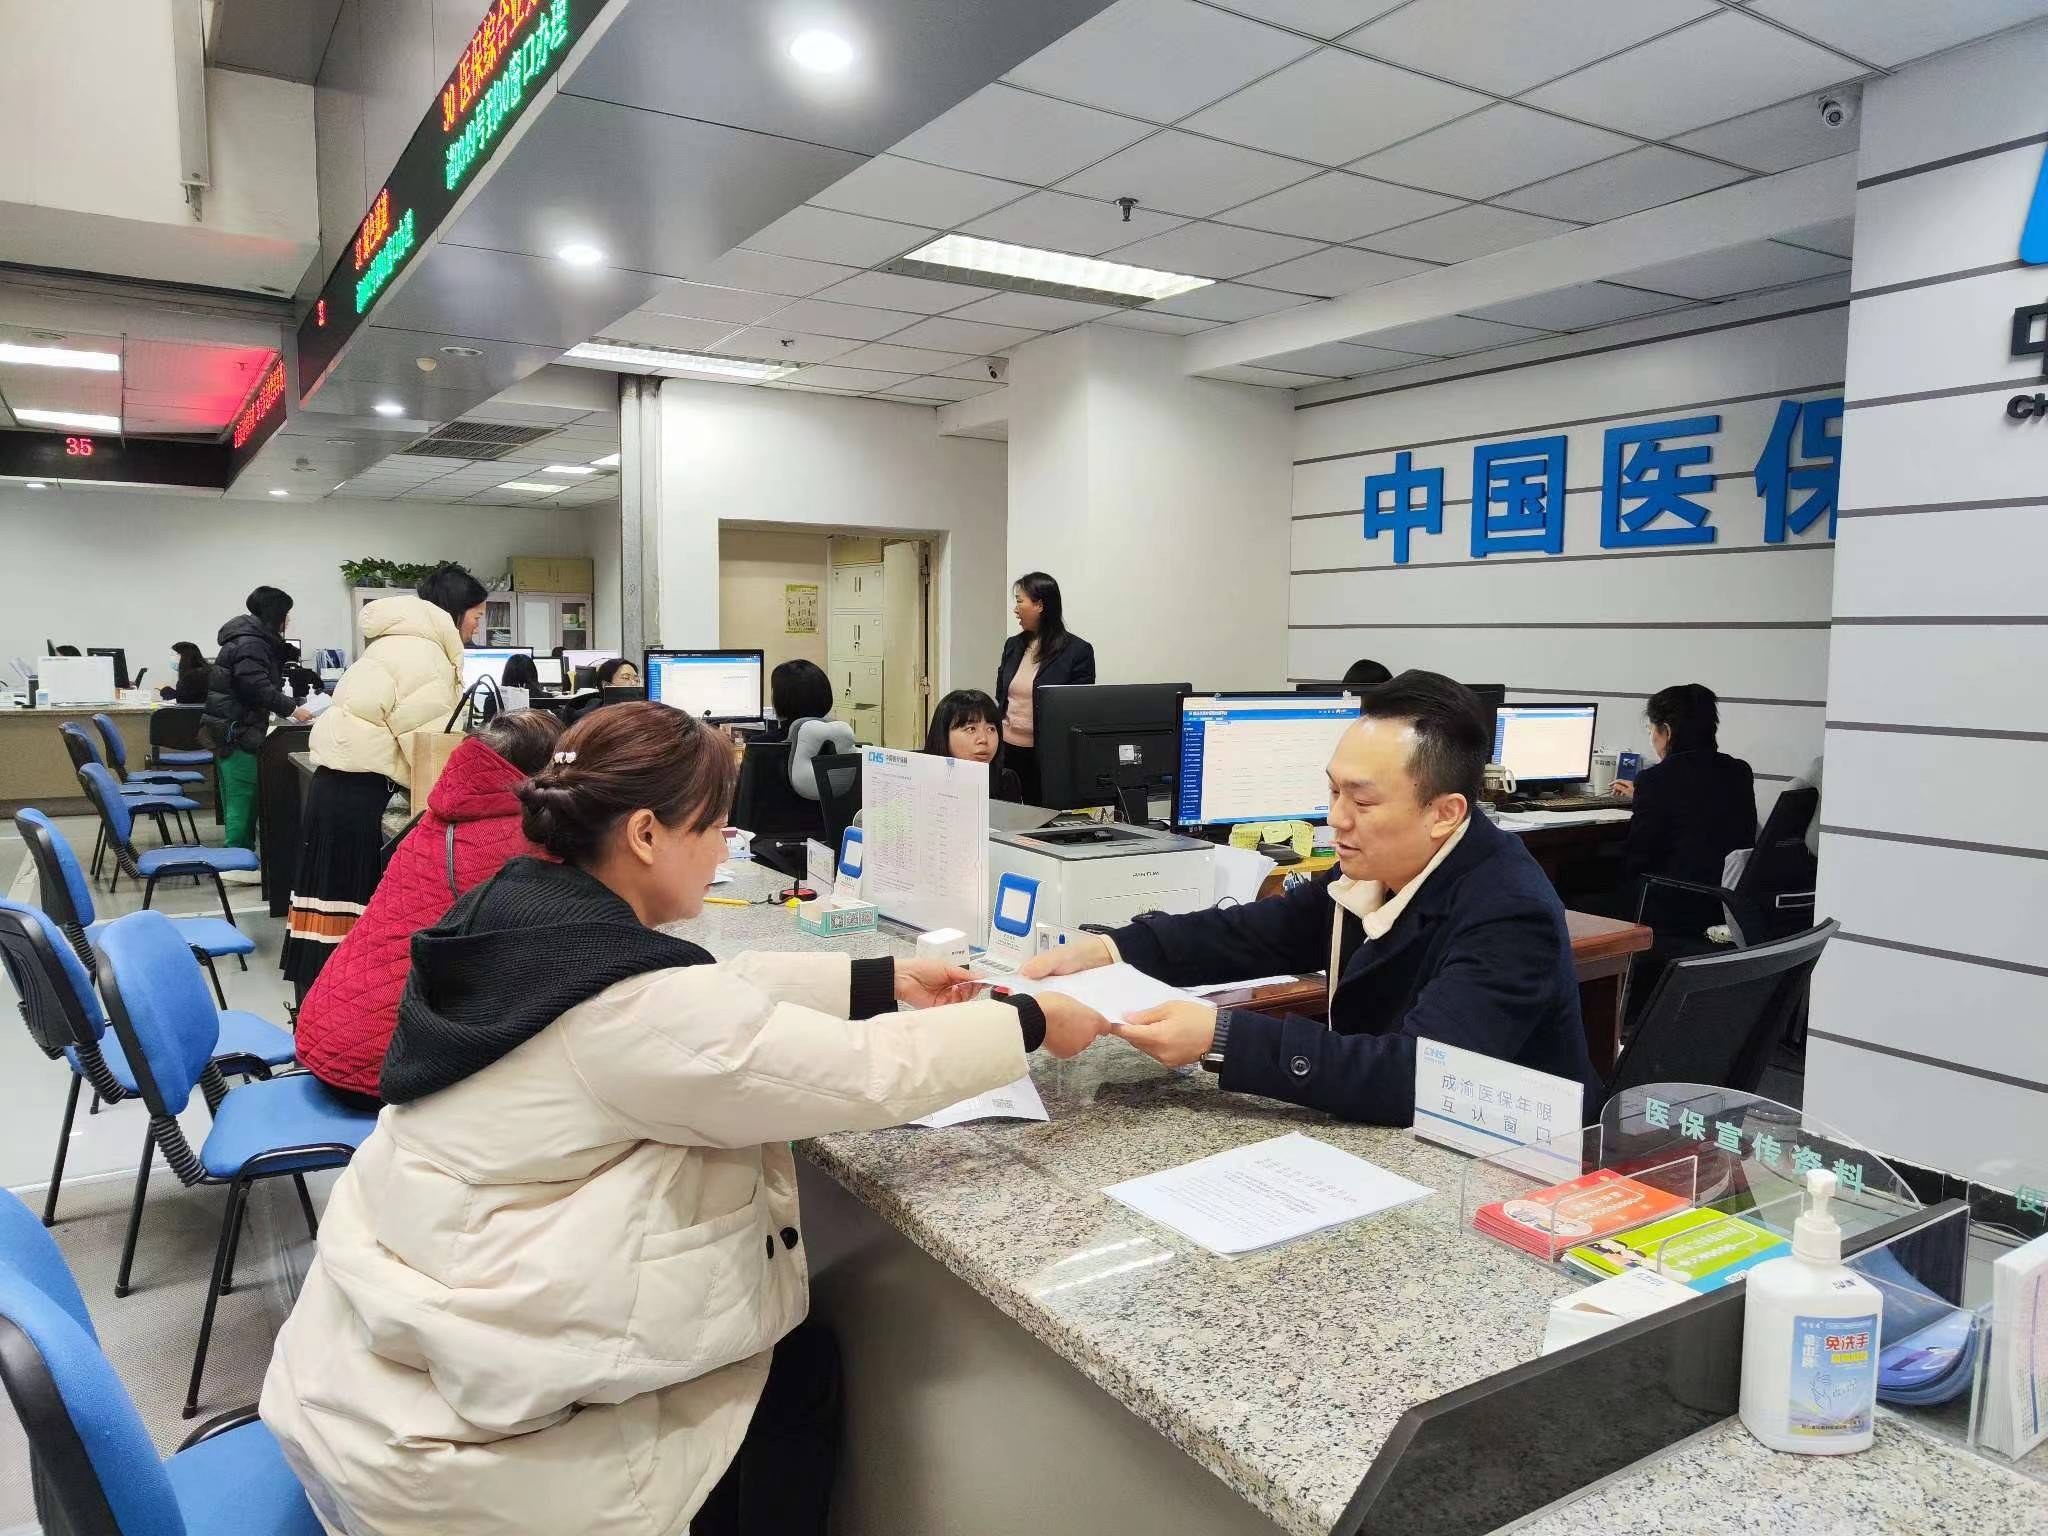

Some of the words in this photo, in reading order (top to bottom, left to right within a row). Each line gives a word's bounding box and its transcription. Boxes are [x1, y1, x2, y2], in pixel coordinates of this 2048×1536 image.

[66, 437, 93, 456] 35
[1363, 397, 1844, 564] 中国医保
[1441, 1073, 1553, 1123] 成渝医保年限
[1645, 1097, 1865, 1199] 医保宣传资料
[1825, 1332, 1869, 1351] 免洗手
